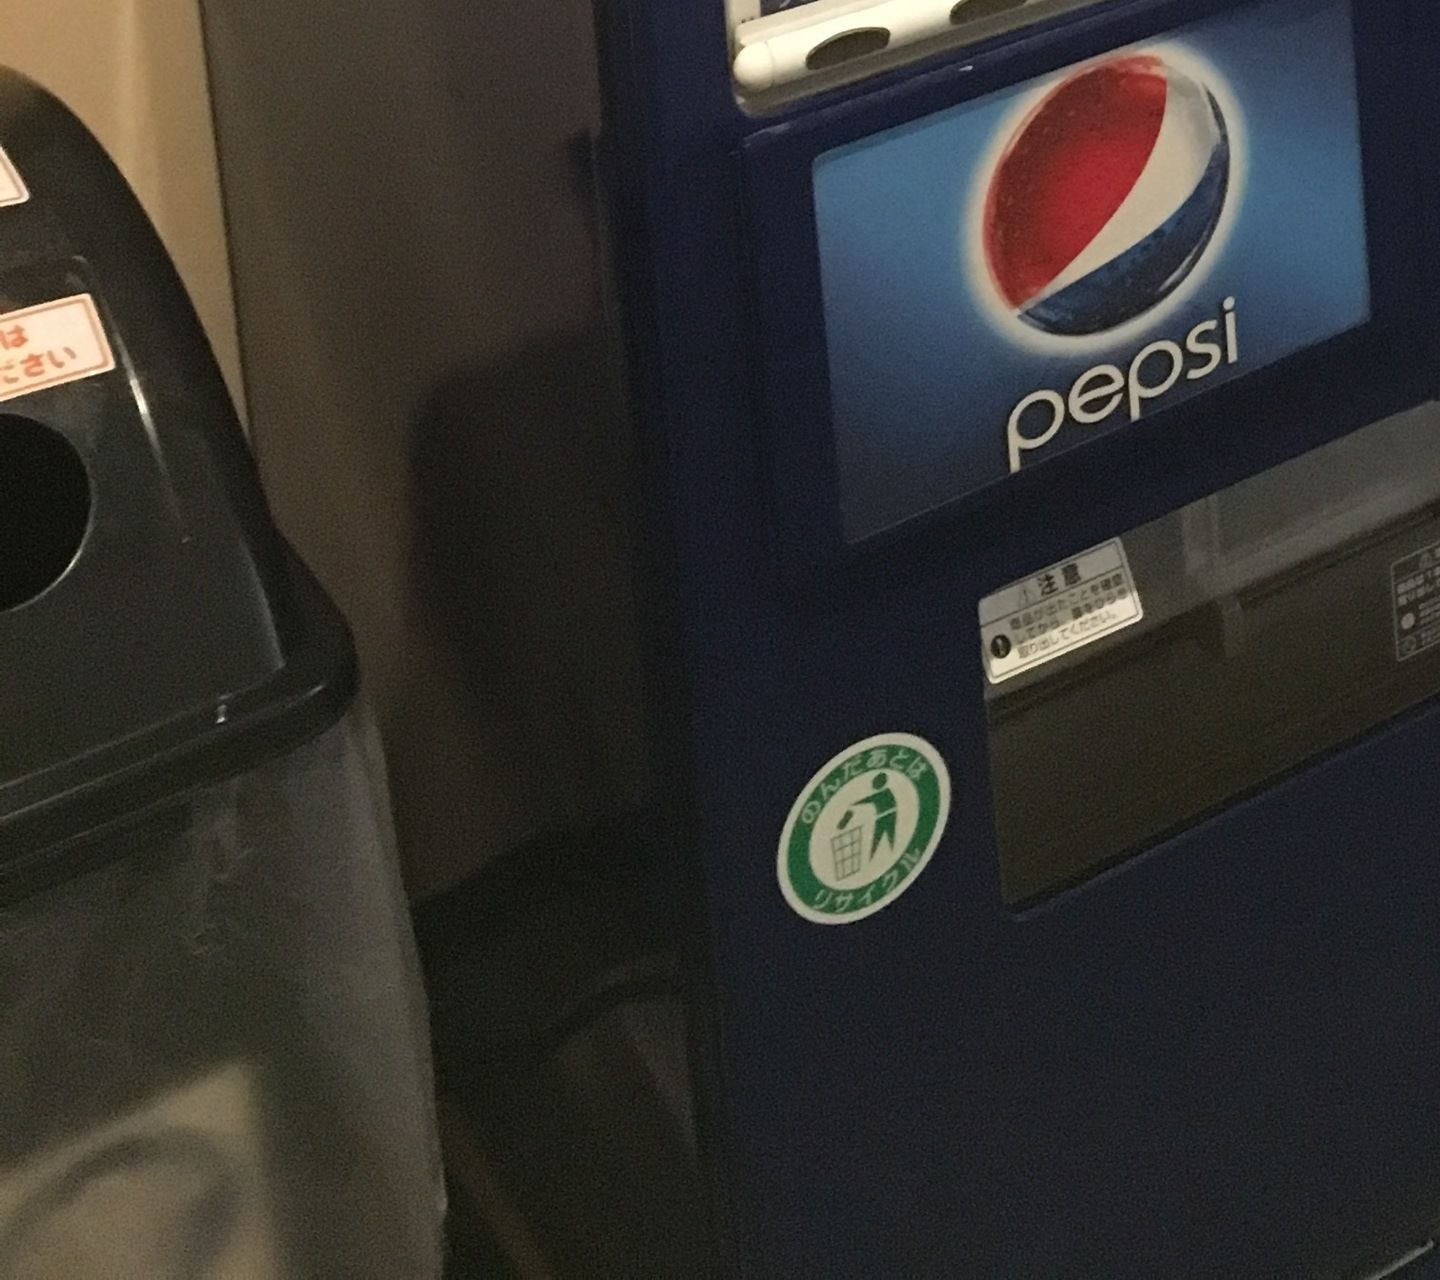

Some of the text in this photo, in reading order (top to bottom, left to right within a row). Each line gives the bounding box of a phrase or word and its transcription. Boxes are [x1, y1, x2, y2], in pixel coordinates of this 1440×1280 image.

[1006, 295, 1239, 474] pepsi
[801, 748, 927, 824] のんだあとは
[813, 847, 921, 913] リサイクル
